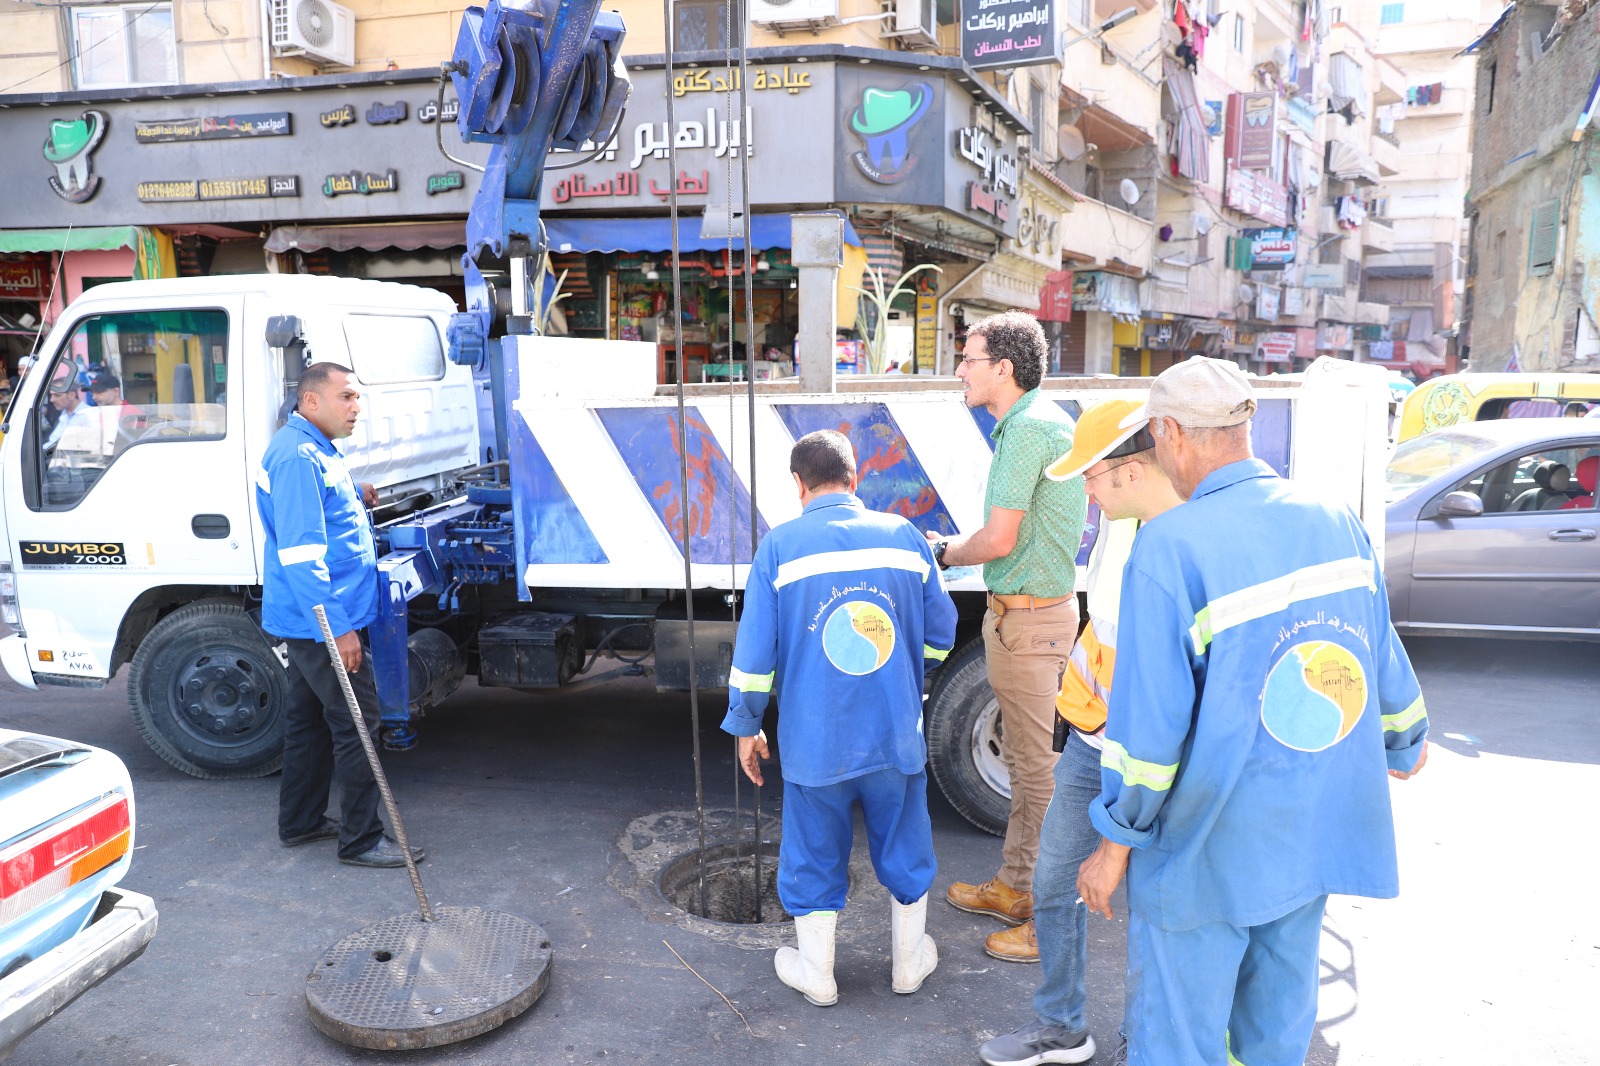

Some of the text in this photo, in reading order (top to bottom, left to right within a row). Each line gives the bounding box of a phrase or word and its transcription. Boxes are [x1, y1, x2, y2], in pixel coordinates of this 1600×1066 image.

[966, 12, 1005, 31] بركات
[1014, 34, 1041, 51] لطب
[664, 66, 812, 97] عيادة الدكتو
[257, 118, 286, 130] المواعيد
[321, 106, 350, 124] غرس
[240, 121, 252, 131] من
[960, 127, 992, 179] بركات
[856, 153, 880, 178] BARAKAT
[201, 179, 267, 197] 01555117445
[273, 178, 295, 193] للحجز
[429, 173, 460, 192] تقويم
[650, 169, 709, 201] لطب
[1255, 230, 1283, 241] معمل
[25, 543, 120, 555] JUMBO
[73, 555, 123, 564] 7000
